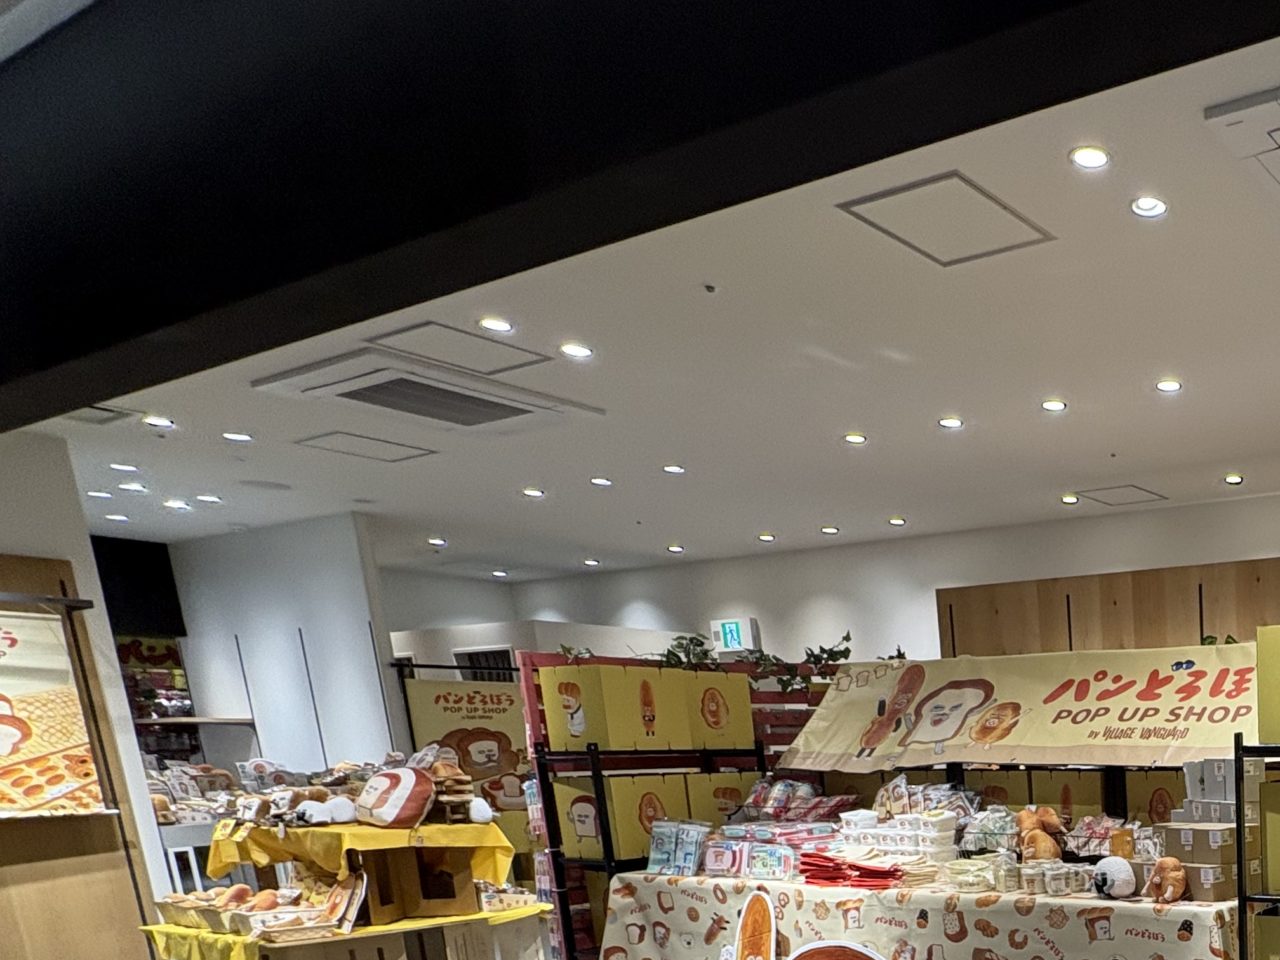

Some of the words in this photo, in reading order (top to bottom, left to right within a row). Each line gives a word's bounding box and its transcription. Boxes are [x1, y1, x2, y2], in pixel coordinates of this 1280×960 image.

[434, 691, 515, 706] パンどろぼう
[1051, 706, 1111, 724] POP
[1117, 707, 1161, 722] UP
[1164, 705, 1253, 724] SHOP
[1087, 730, 1100, 739] by
[1102, 726, 1138, 740] VILLAGE
[1139, 726, 1189, 741] VANGUARD
[1125, 927, 1166, 942] パンどろぼう
